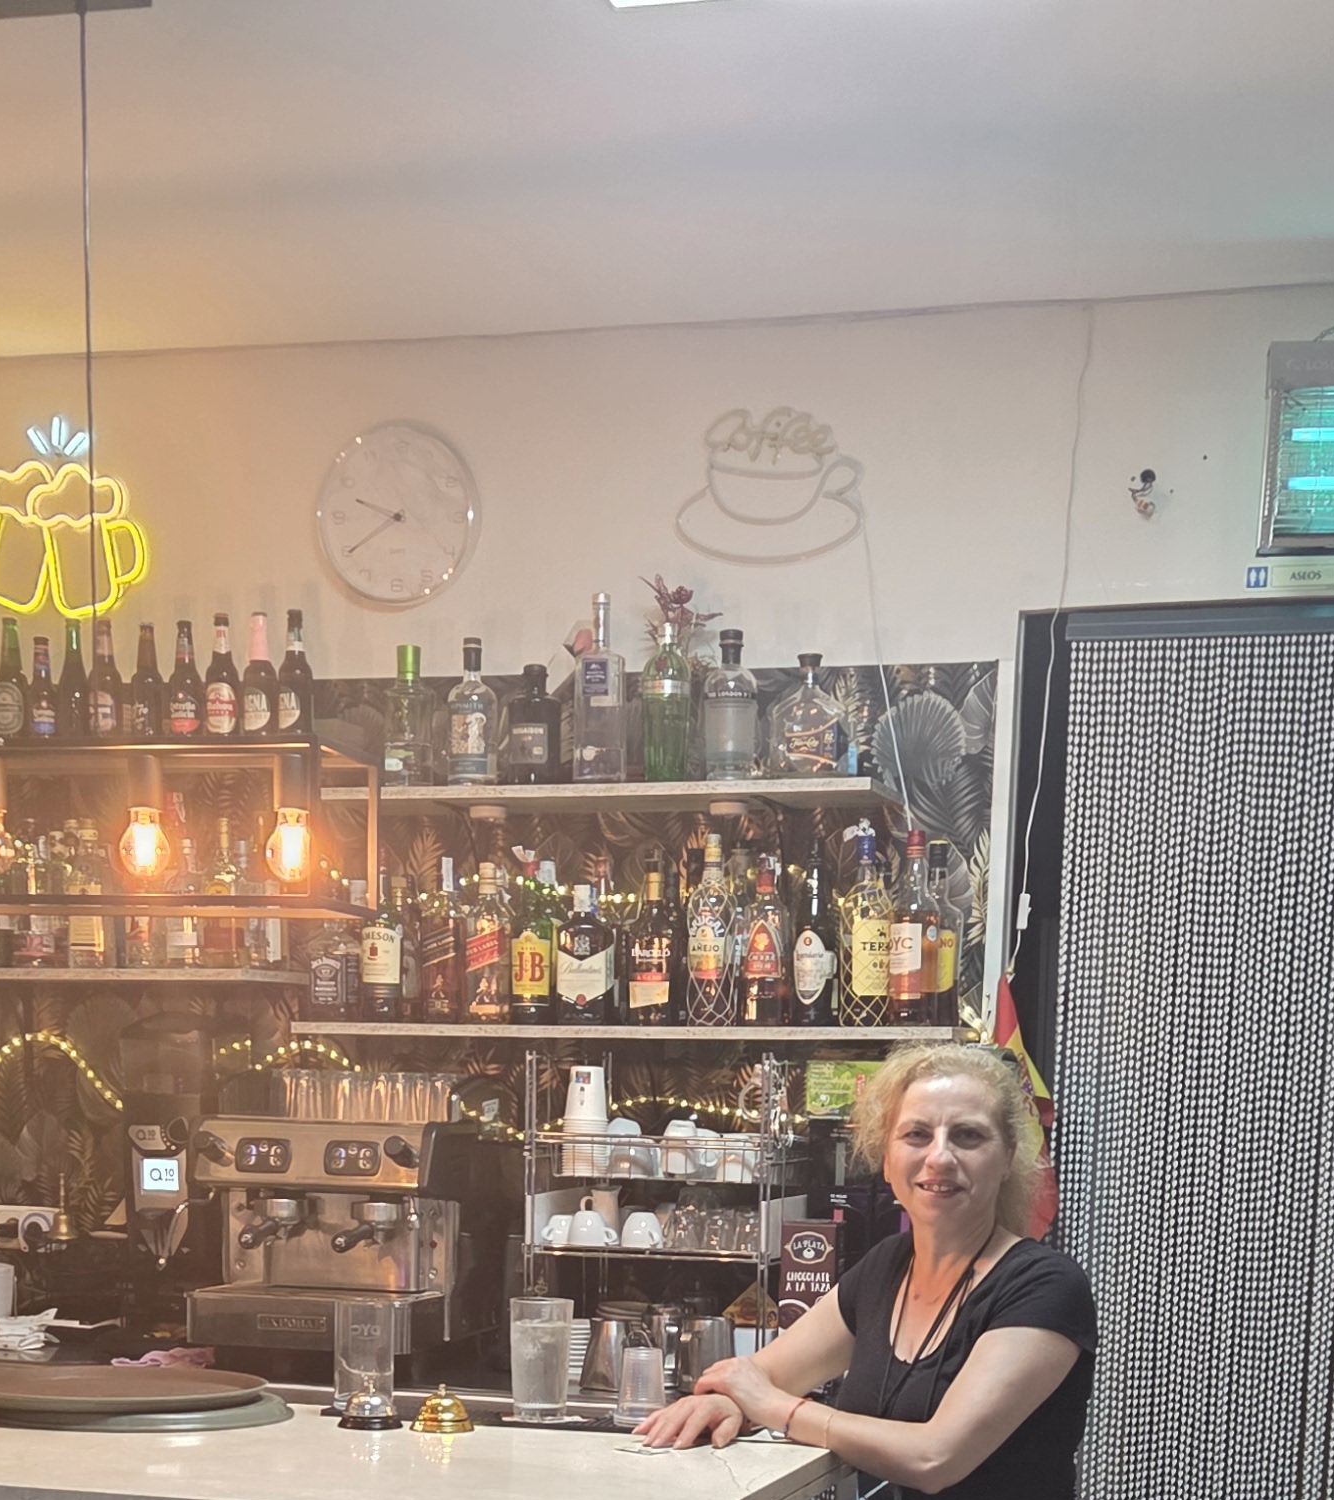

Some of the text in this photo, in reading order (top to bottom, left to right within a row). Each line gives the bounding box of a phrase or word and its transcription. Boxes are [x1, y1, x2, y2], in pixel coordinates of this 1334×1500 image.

[704, 406, 836, 466] Coffee
[1289, 570, 1322, 582] ASEOS
[364, 931, 396, 944] MESON
[691, 942, 720, 953] AÑEJO
[785, 1282, 793, 1292] A
[795, 1282, 807, 1292] LA
